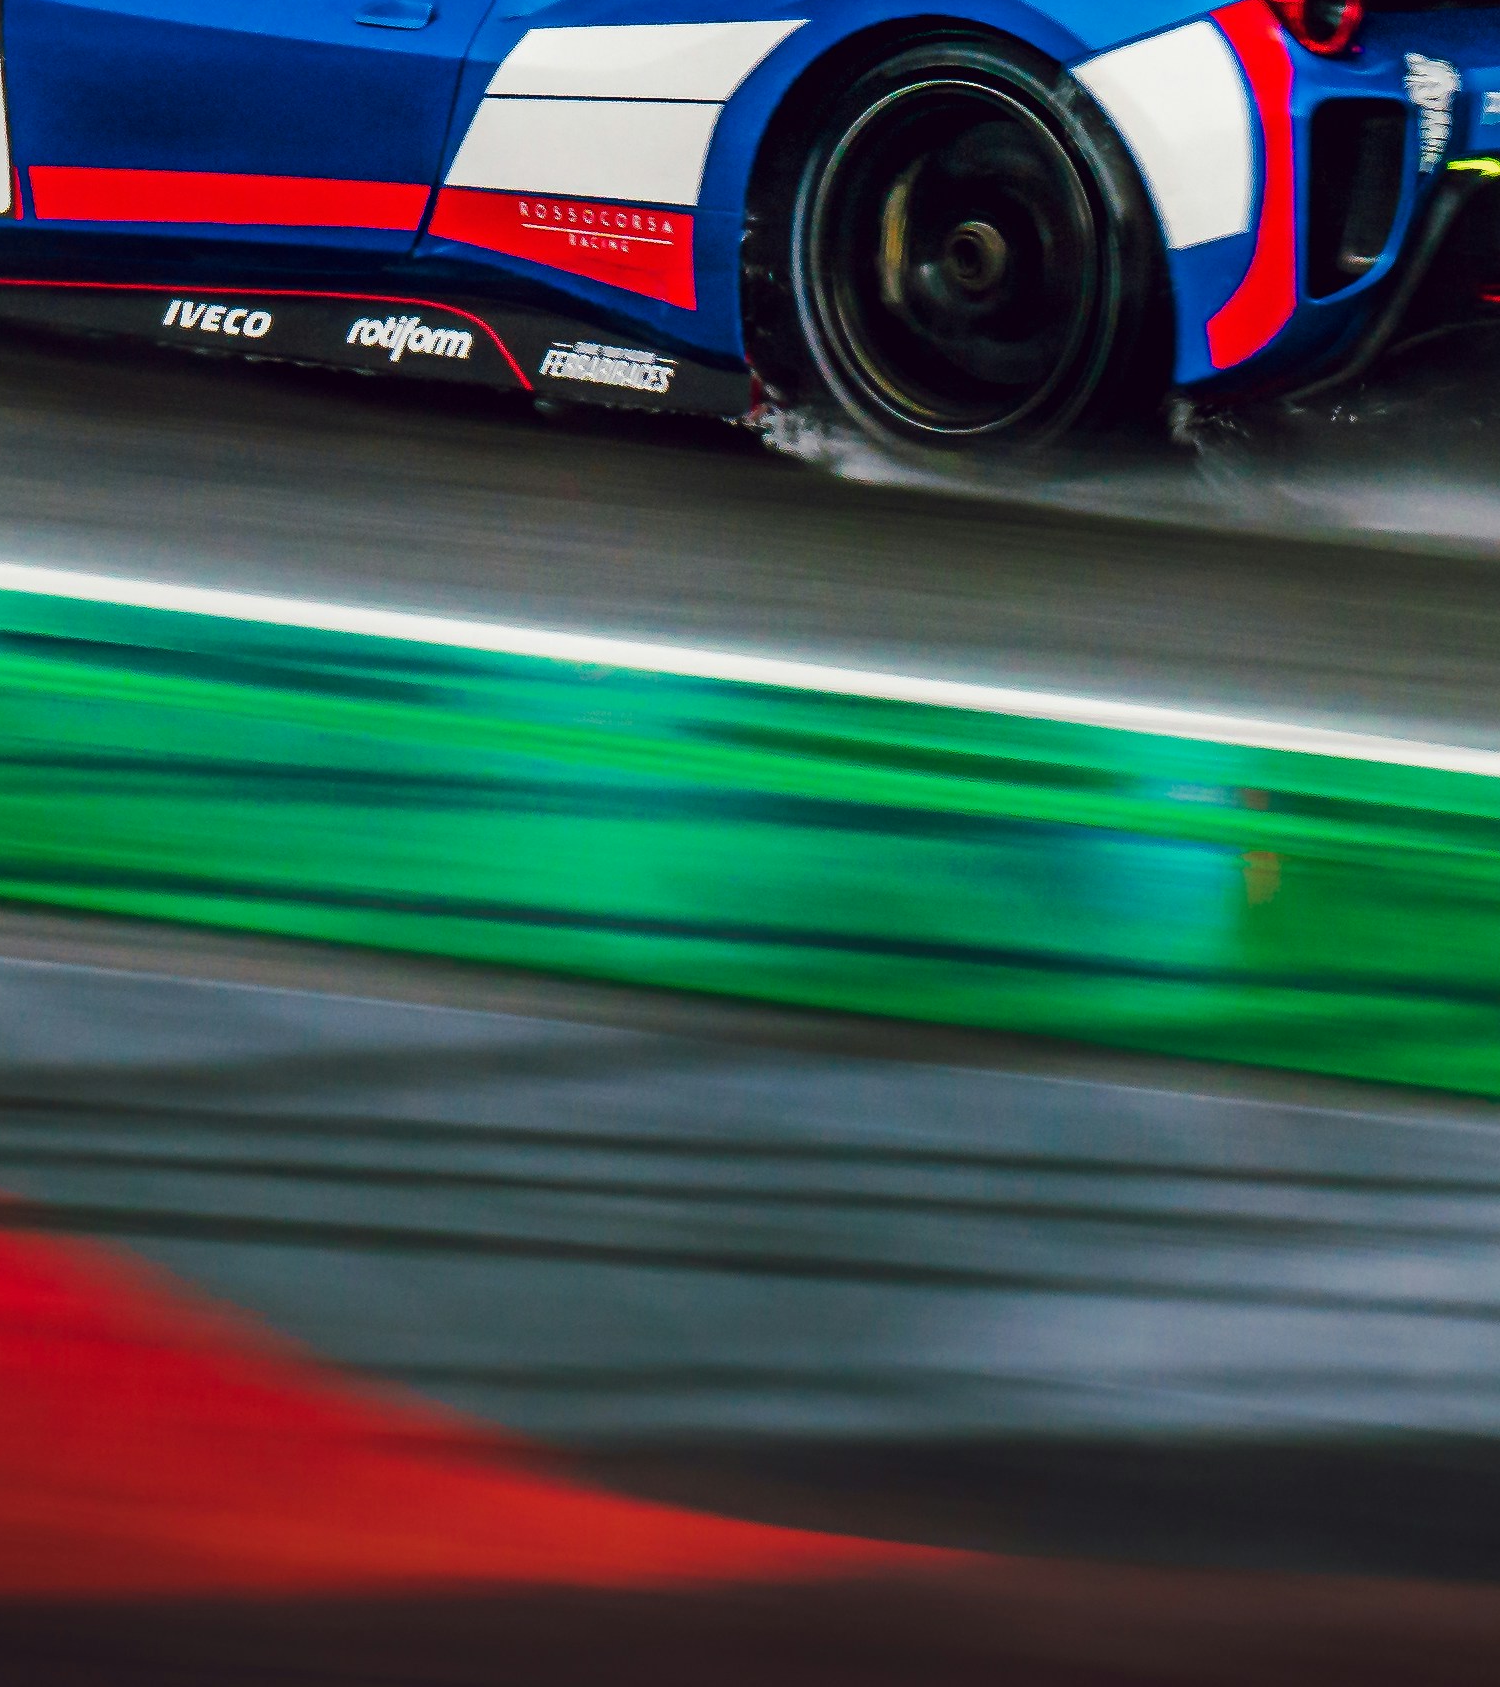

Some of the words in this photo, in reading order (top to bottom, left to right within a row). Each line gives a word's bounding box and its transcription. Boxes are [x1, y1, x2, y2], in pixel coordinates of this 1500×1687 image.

[518, 200, 675, 235] ROSSOCORSA
[161, 299, 273, 339] IVECO
[346, 315, 474, 363] rotiform
